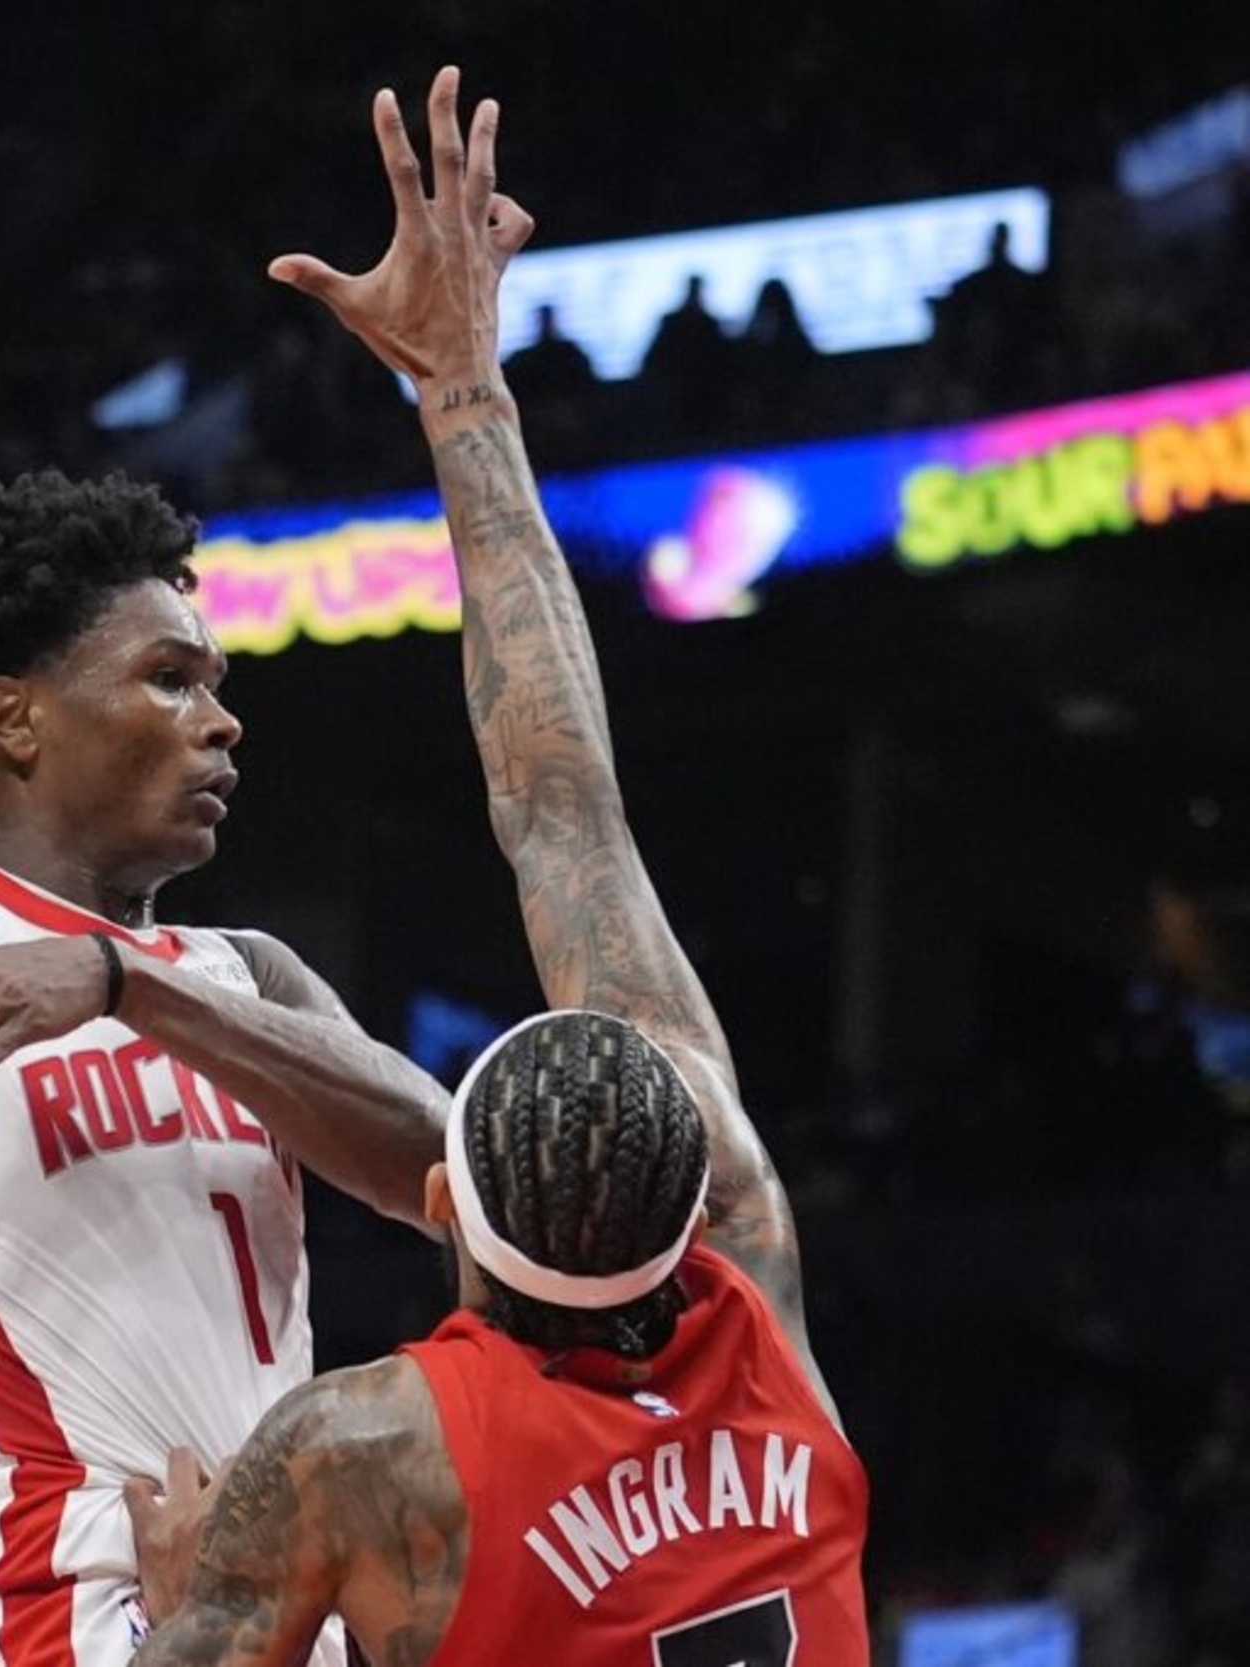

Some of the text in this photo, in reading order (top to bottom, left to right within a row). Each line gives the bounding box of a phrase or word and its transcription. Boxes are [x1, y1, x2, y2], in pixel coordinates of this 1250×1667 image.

[898, 408, 1250, 569] SOUR PA
[19, 1036, 295, 1193] ROCKE
[210, 1192, 276, 1365] 1
[523, 1429, 812, 1610] INGRAM
